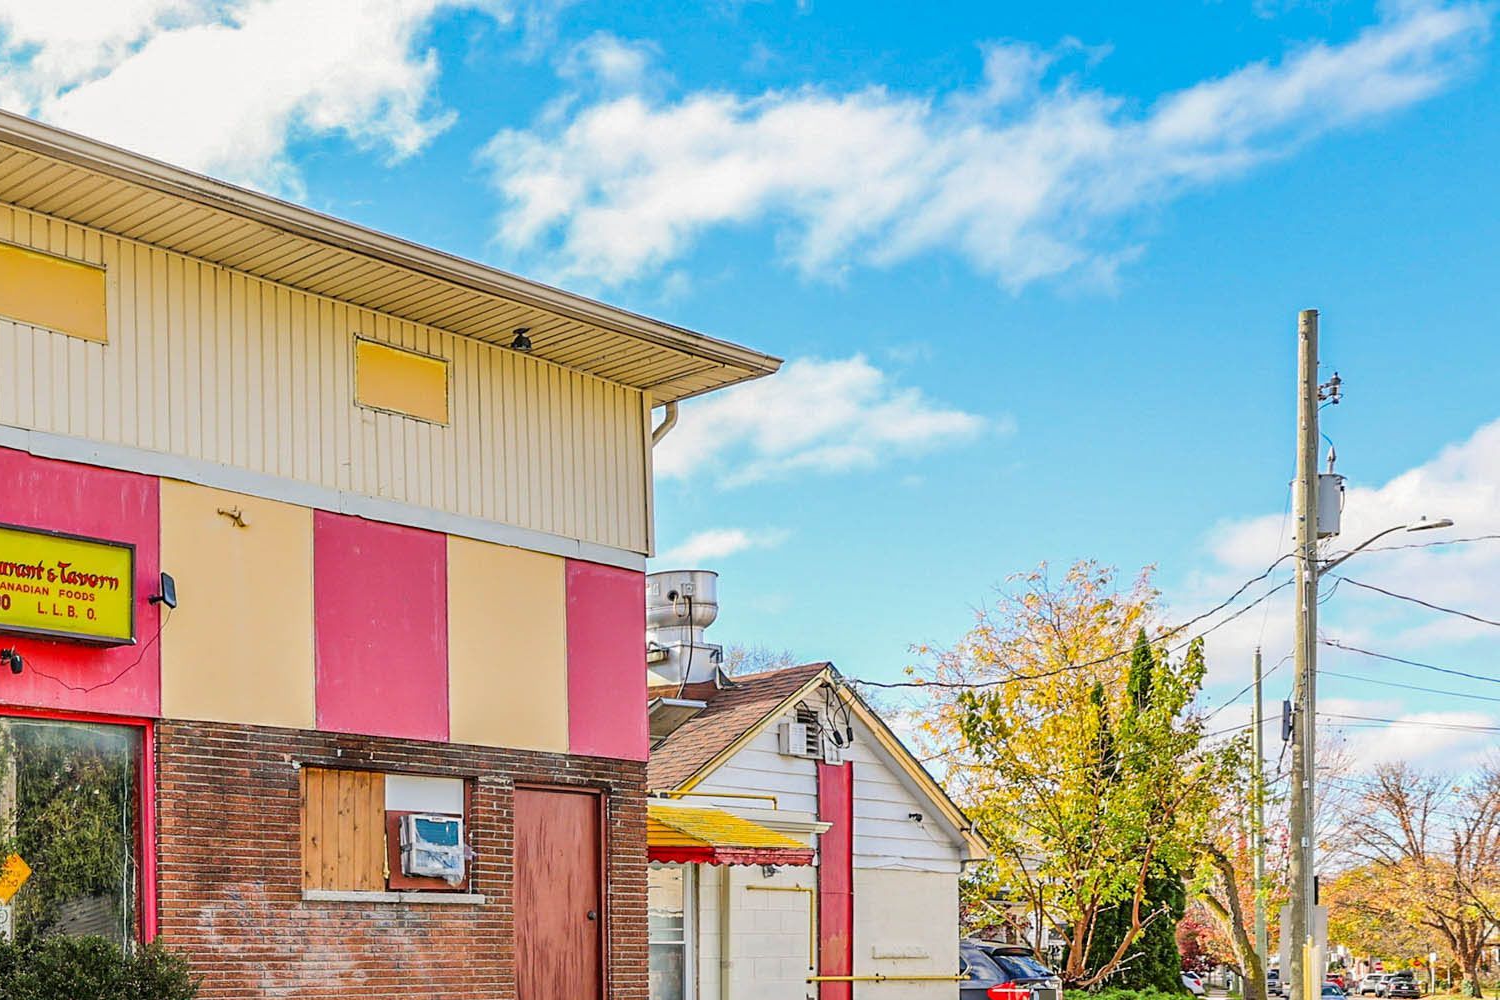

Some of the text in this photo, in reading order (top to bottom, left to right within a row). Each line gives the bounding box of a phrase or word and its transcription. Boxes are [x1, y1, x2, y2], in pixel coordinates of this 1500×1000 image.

[46, 568, 58, 584] &
[57, 560, 120, 590] Tavern
[58, 588, 96, 602] FOODS
